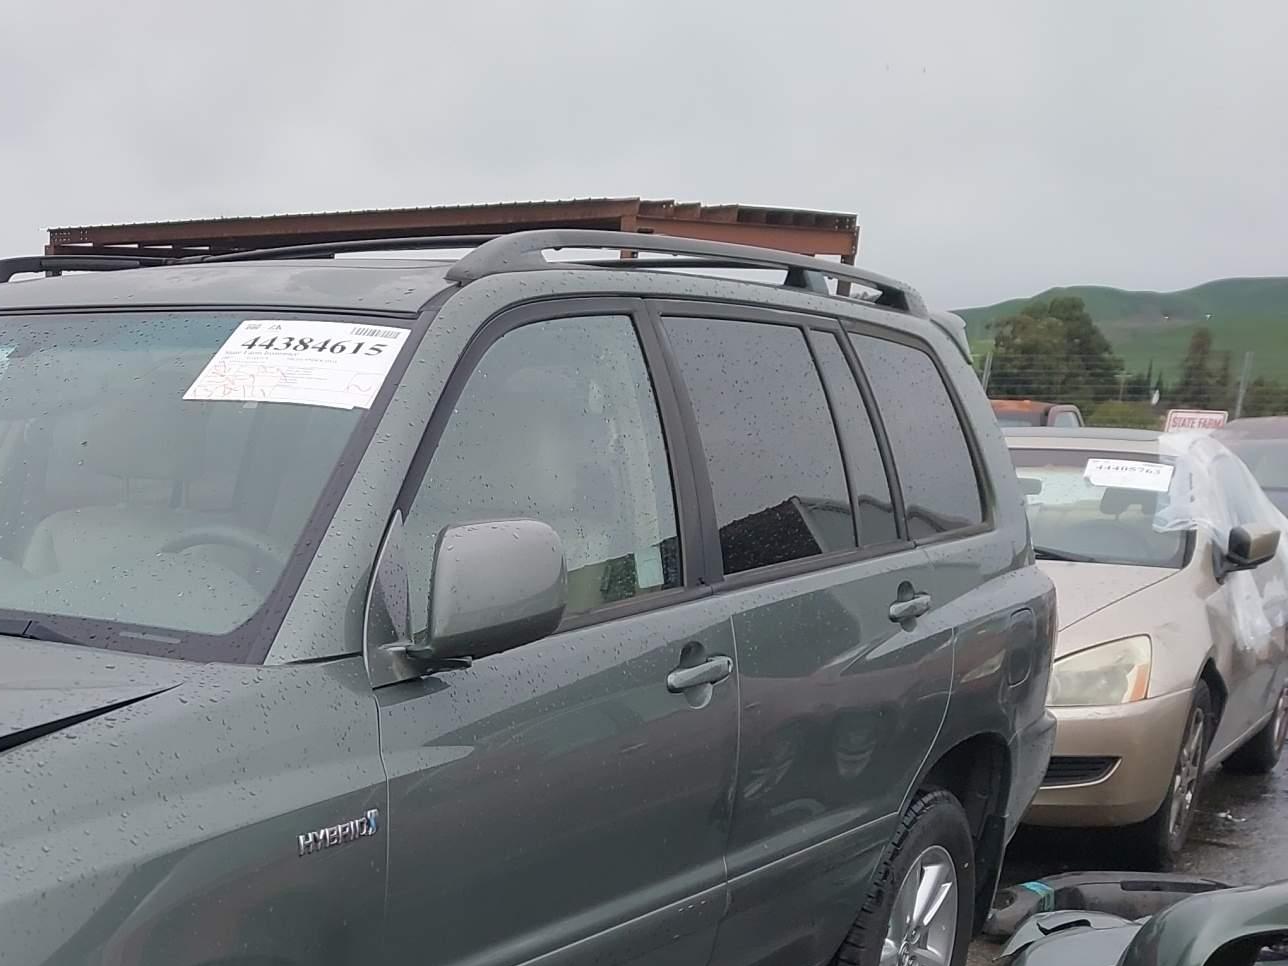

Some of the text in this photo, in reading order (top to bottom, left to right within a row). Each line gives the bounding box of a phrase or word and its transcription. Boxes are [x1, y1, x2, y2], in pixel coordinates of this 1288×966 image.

[240, 335, 388, 356] 44384615
[1172, 416, 1224, 430] STATE FARM
[297, 816, 368, 856] HYBRID
